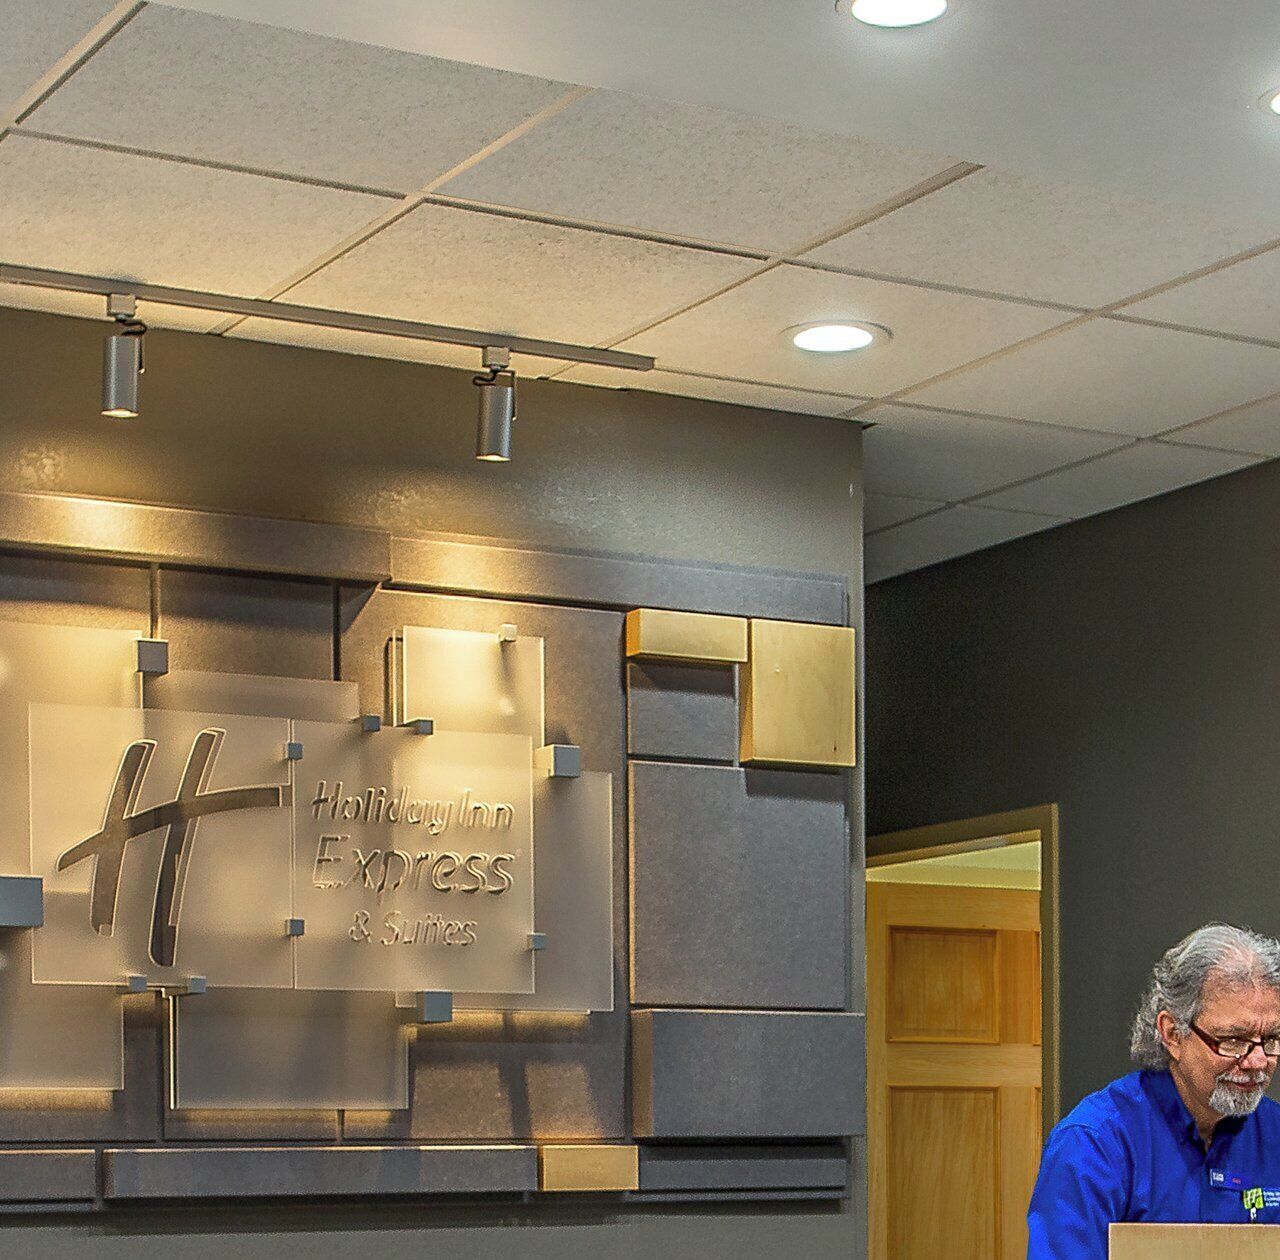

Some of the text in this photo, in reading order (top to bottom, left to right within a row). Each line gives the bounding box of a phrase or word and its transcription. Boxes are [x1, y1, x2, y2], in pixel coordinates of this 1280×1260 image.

[312, 779, 516, 835] Holiday Inn
[312, 834, 517, 905] Express
[348, 909, 478, 946] & Suites
